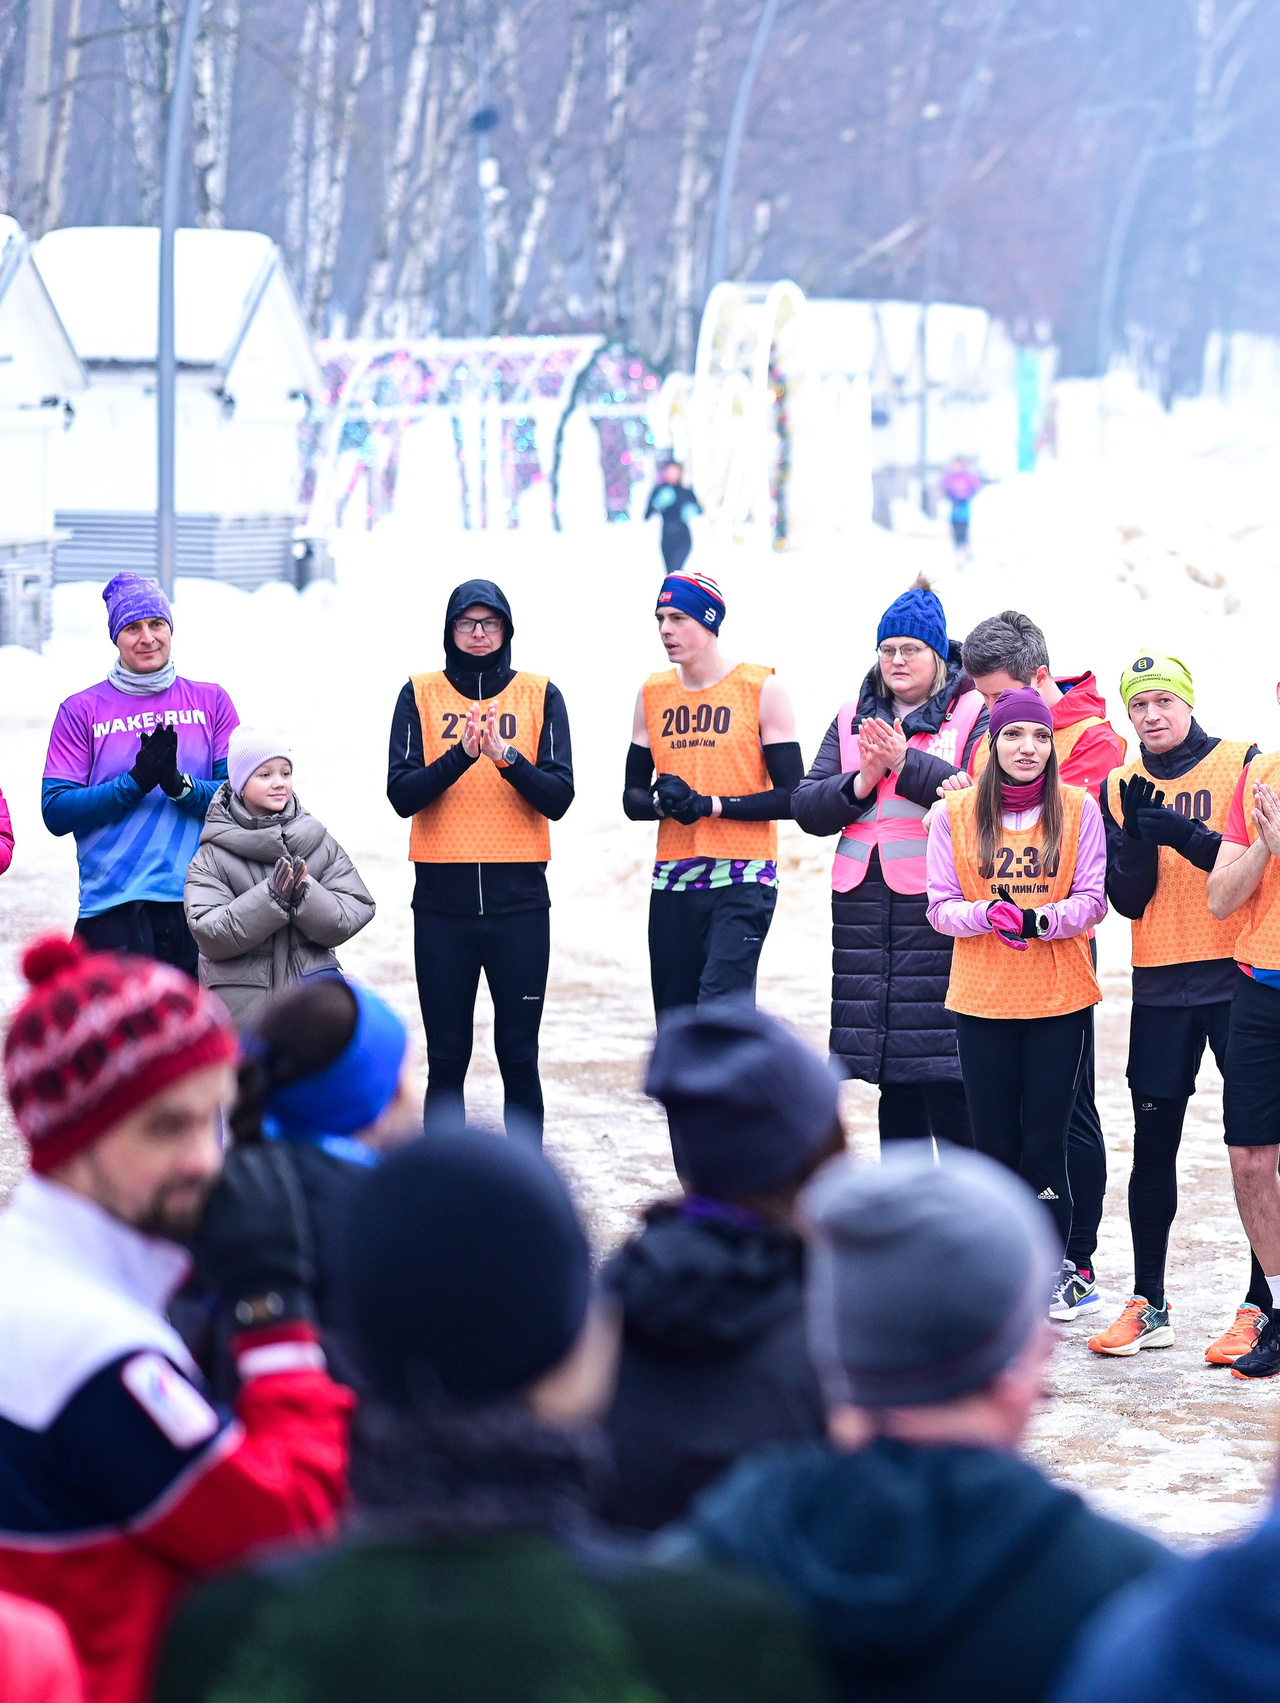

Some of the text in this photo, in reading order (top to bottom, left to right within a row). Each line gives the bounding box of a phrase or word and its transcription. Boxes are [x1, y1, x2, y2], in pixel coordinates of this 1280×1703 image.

[661, 703, 731, 737] 20:00
[670, 739, 687, 750] 4:00
[1012, 883, 1049, 894] мин/км
